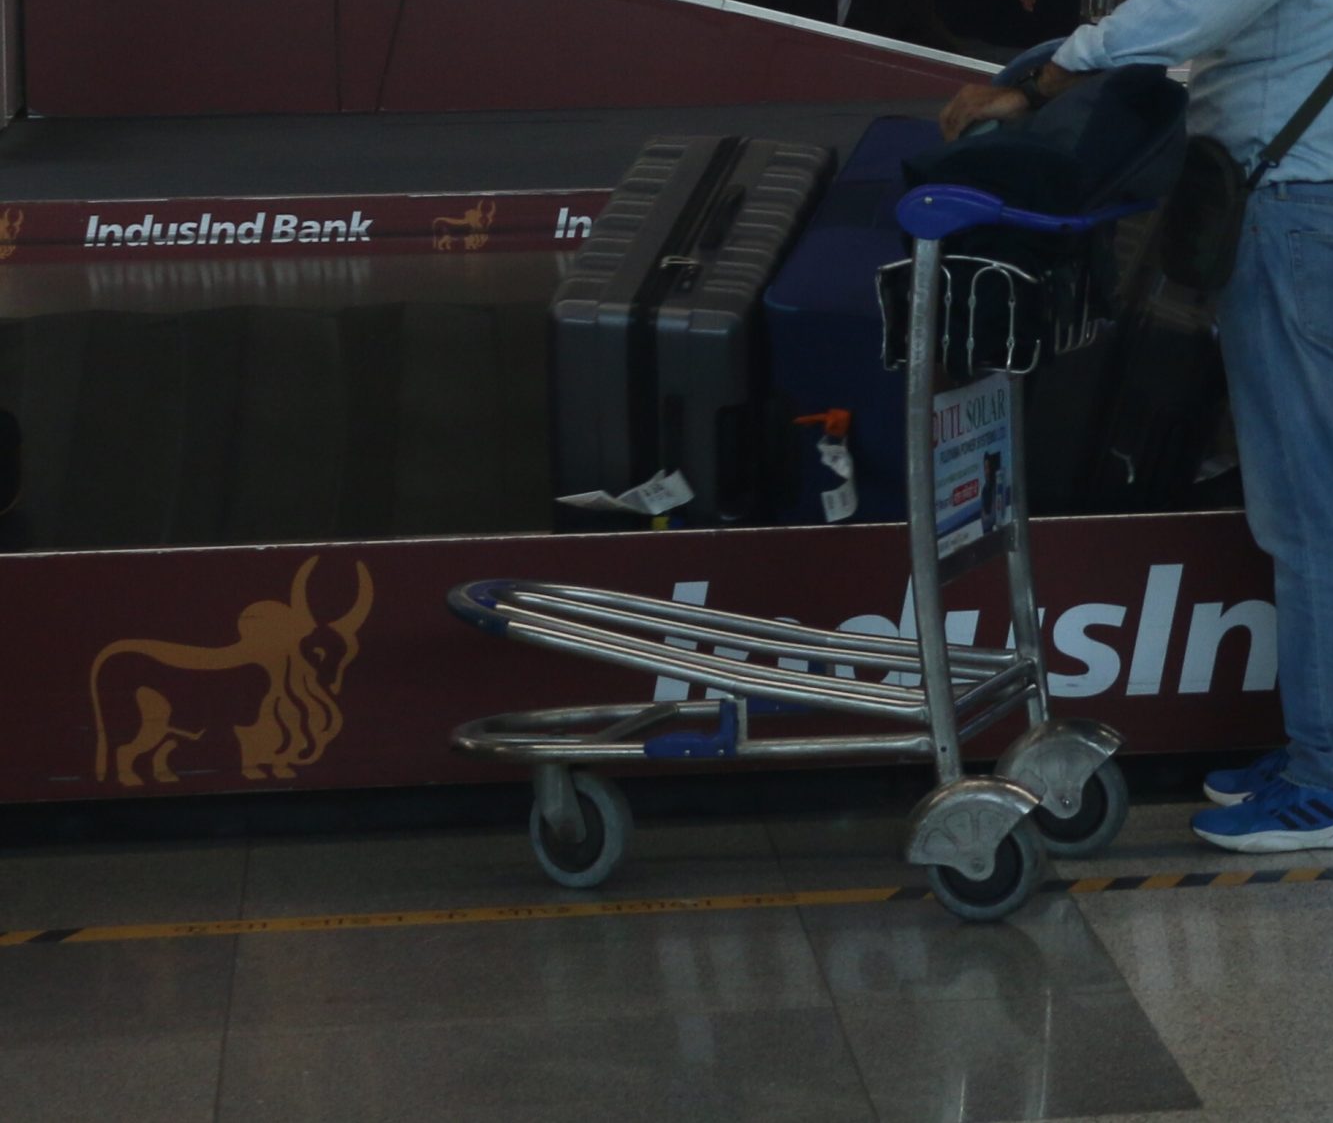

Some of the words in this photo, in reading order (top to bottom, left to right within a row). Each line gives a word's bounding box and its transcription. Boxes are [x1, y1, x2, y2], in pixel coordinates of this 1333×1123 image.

[84, 213, 267, 248] IndusInd
[271, 210, 374, 243] Bank
[939, 403, 963, 443] UTL
[965, 388, 1006, 432] SOLAR
